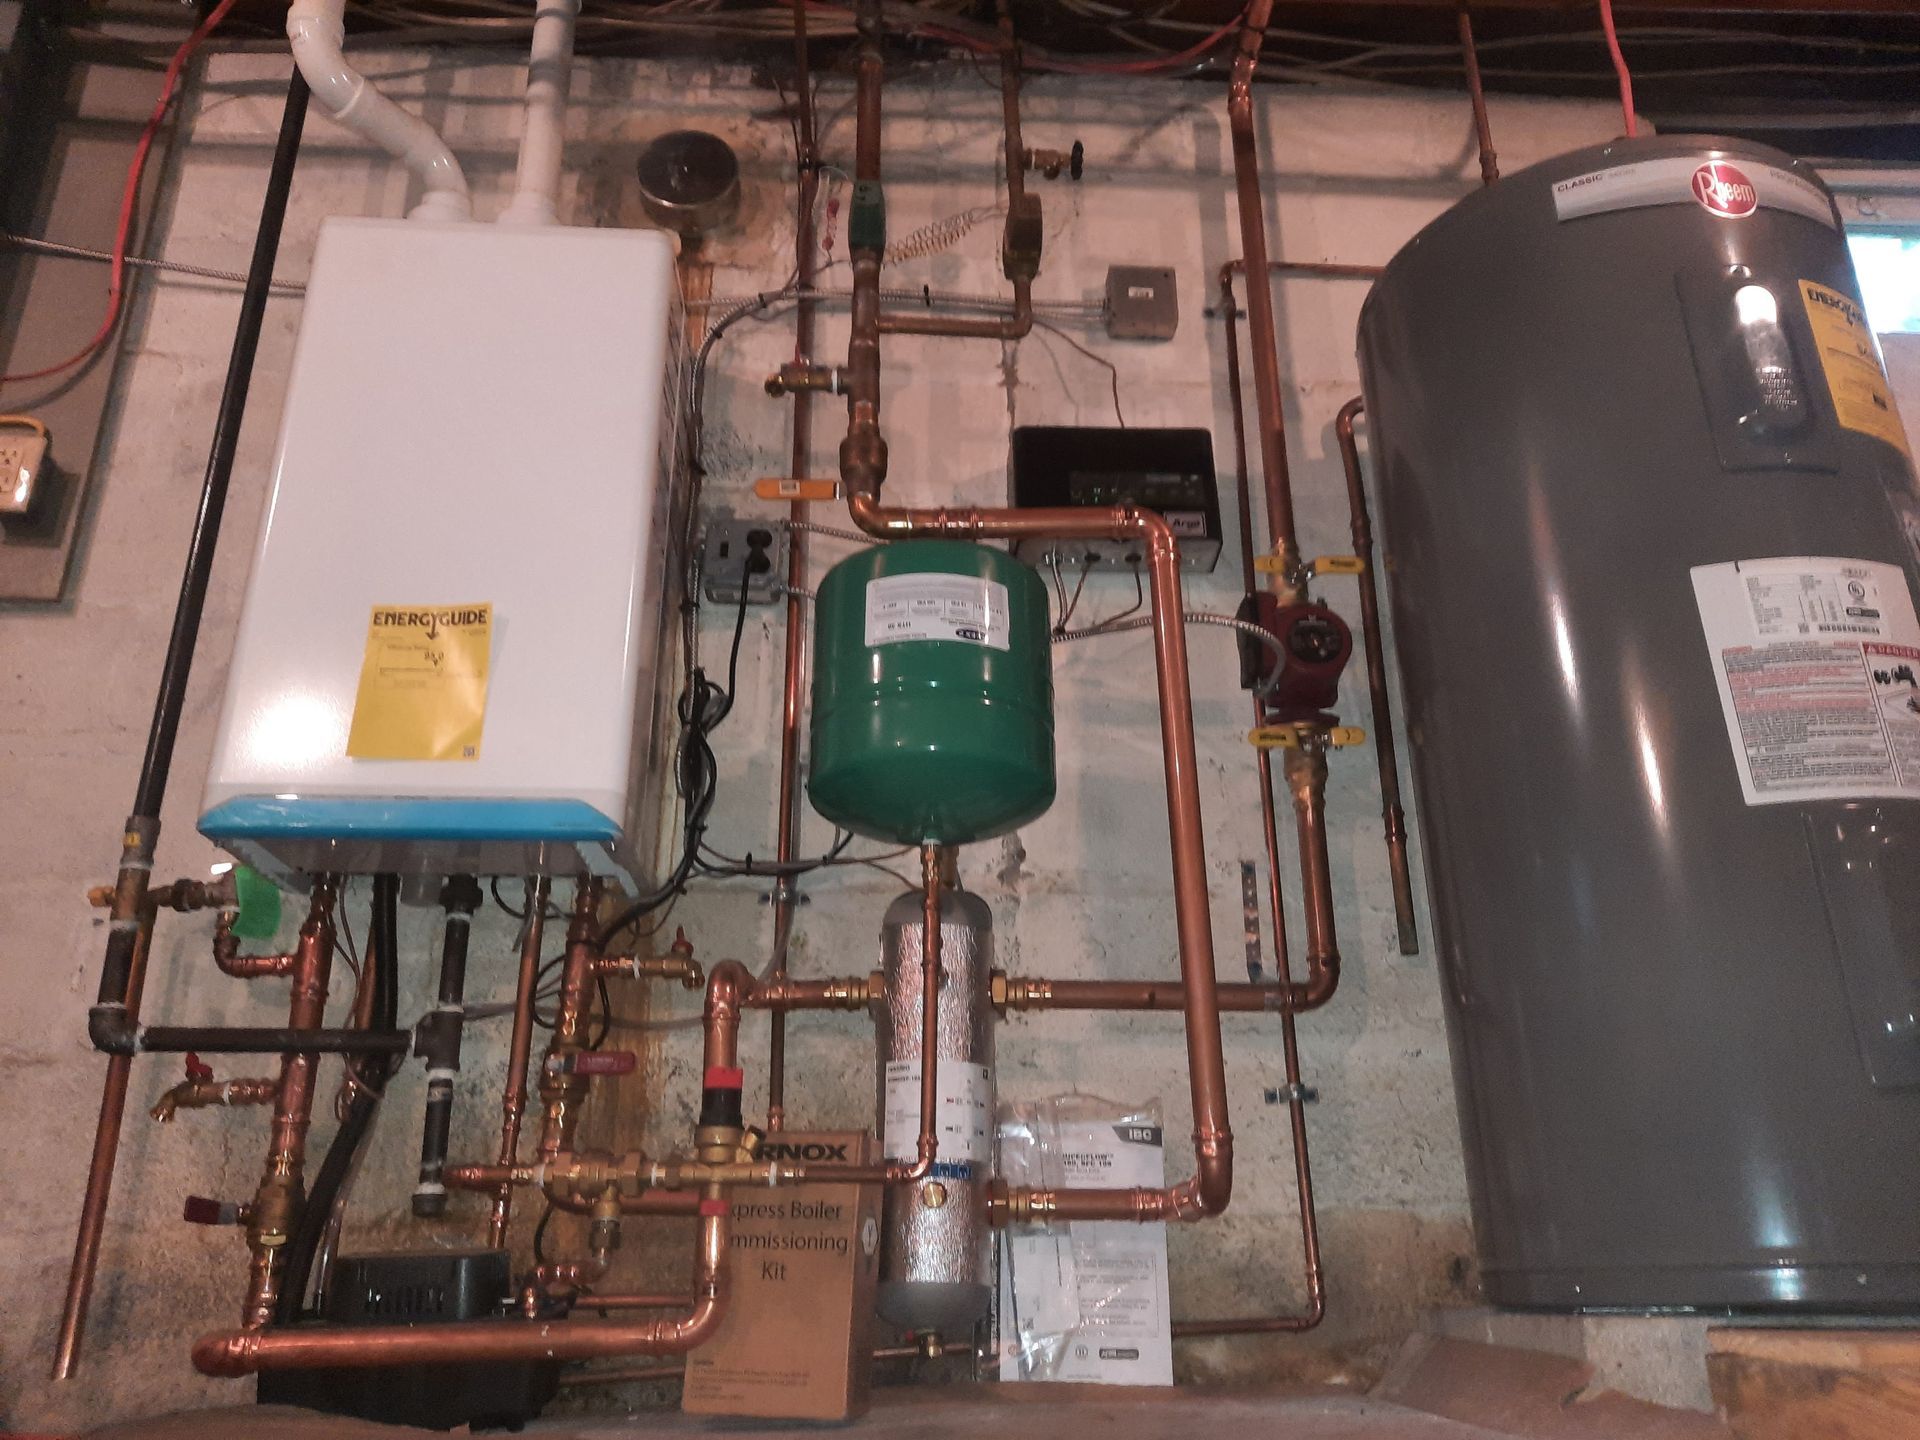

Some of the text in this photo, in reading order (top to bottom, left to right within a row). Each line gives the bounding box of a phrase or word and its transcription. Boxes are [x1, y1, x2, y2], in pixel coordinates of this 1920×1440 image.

[1557, 173, 1603, 192] CLASSIC
[1698, 160, 1754, 208] Rheem
[1173, 518, 1201, 529] Argo
[373, 608, 488, 630] ENERGYGUIDE
[1128, 1128, 1152, 1141] IBC
[755, 1143, 848, 1162] RNOX
[731, 1200, 843, 1222] xpress Boiler
[731, 1231, 849, 1255] mmissioning
[761, 1260, 787, 1281] Kit
